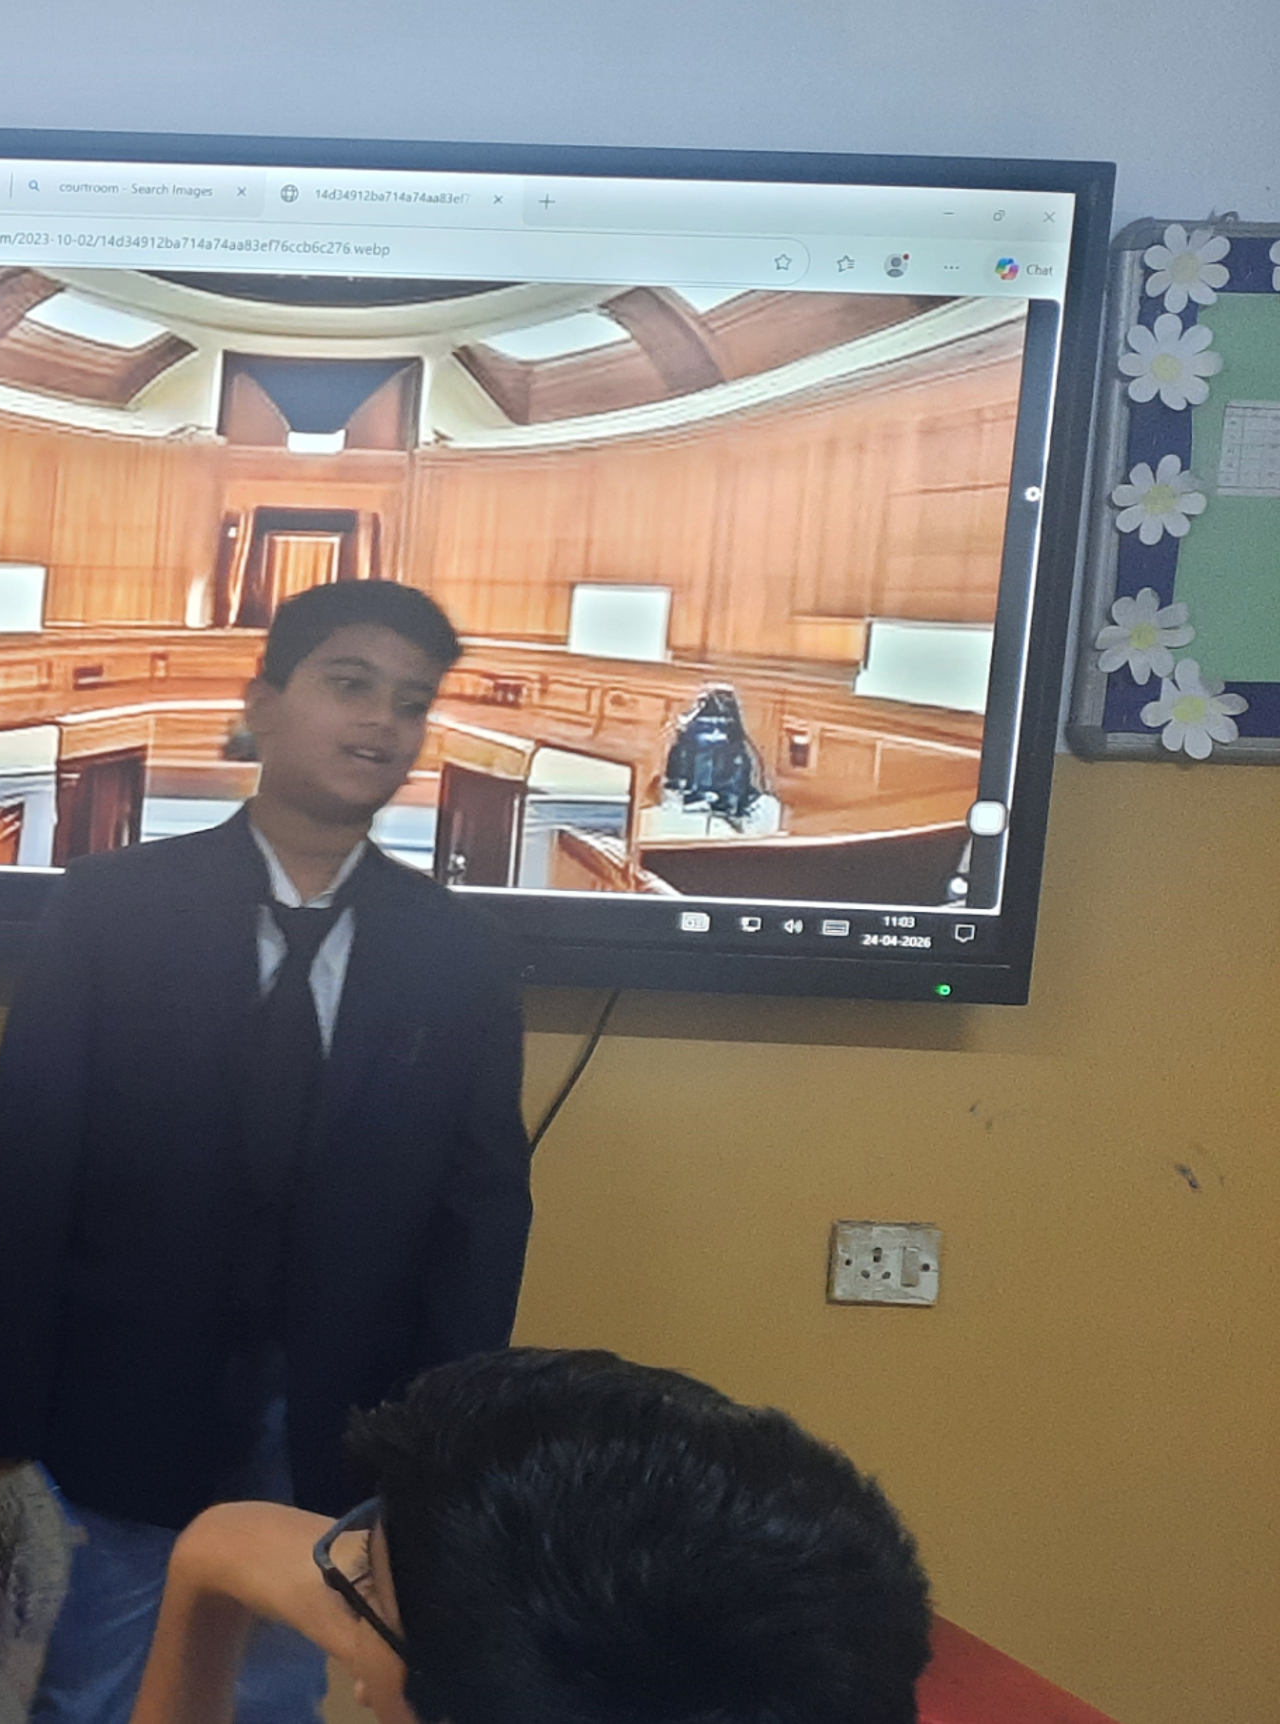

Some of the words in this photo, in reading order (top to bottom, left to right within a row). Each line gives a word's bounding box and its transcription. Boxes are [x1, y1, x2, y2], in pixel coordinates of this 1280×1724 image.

[58, 182, 120, 194] courtroom
[131, 182, 169, 196] Search
[172, 184, 214, 199] Images
[1025, 263, 1054, 278] Chat
[883, 916, 916, 929] 11:03
[861, 933, 932, 949] 24-04-2026
